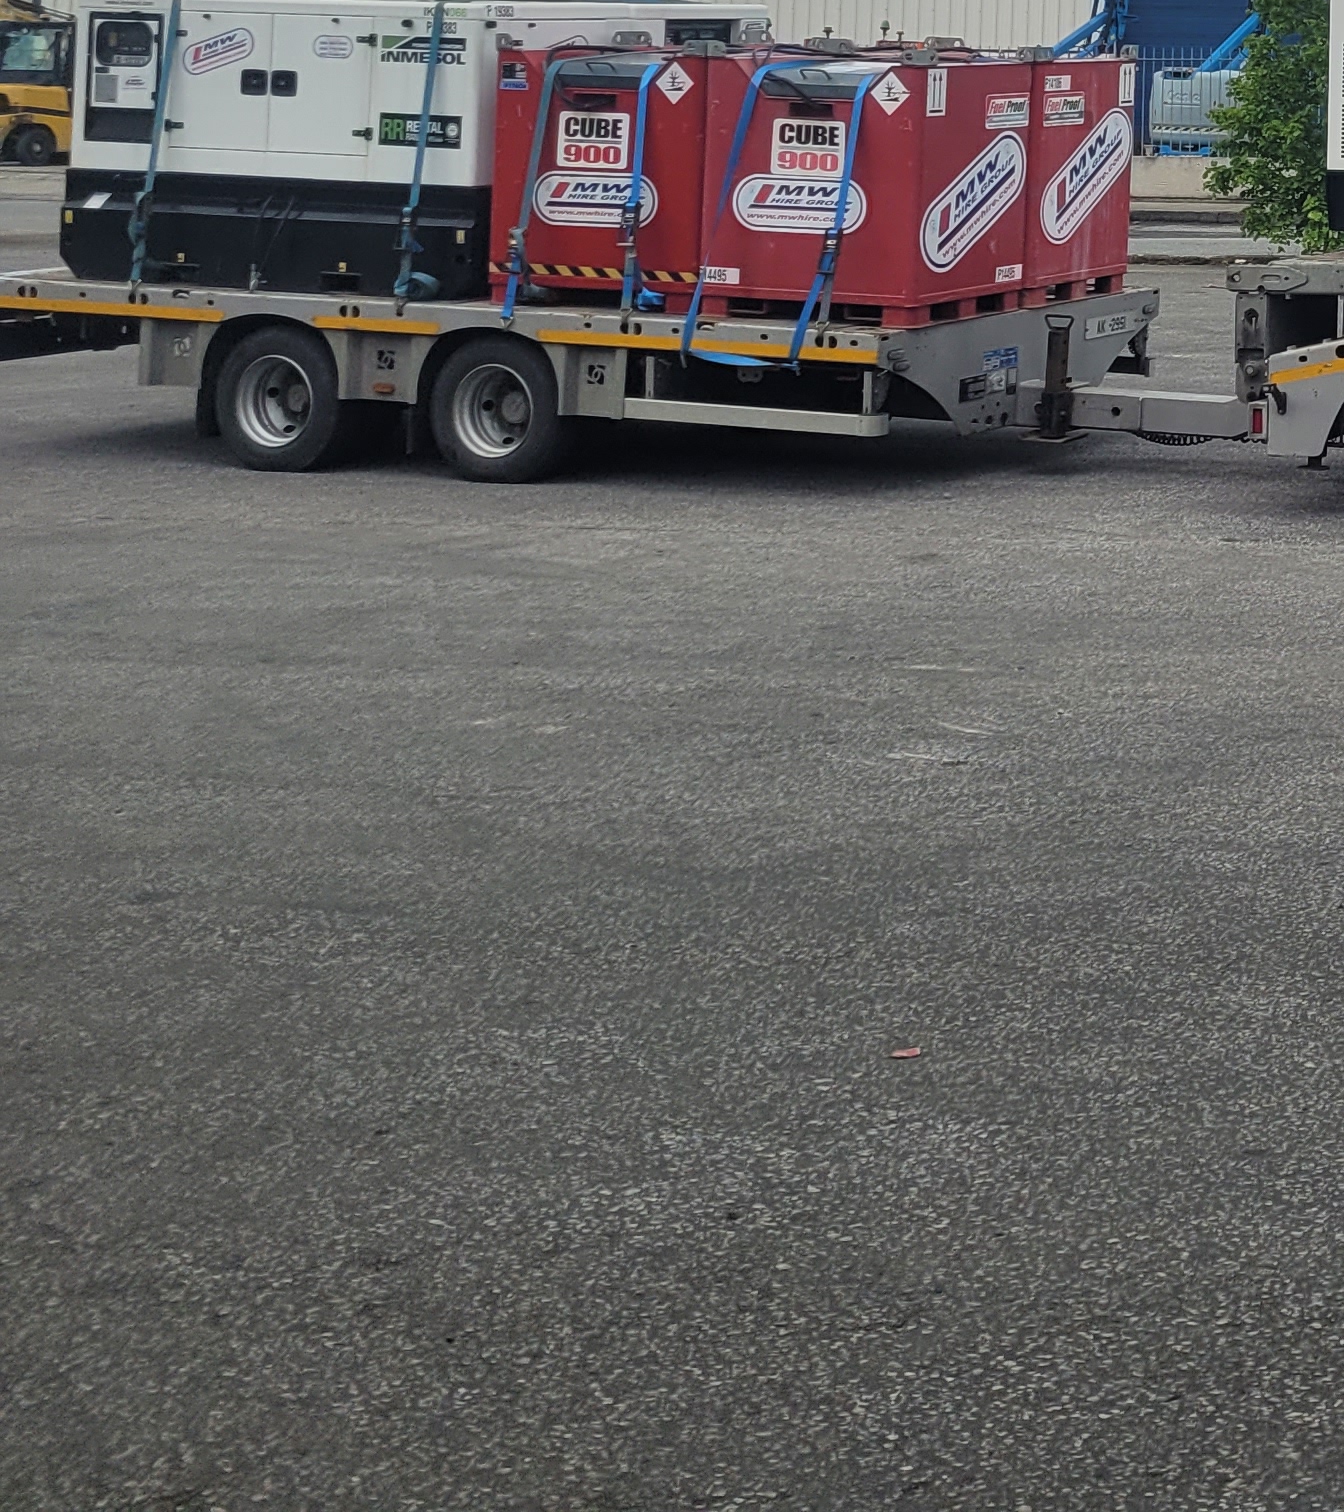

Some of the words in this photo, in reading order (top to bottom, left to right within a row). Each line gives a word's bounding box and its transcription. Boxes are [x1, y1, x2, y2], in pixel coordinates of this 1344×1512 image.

[203, 34, 238, 52] MW
[381, 118, 405, 141] RR
[564, 116, 623, 139] CUBE
[779, 123, 839, 147] CUBE
[563, 144, 621, 165] 900
[777, 151, 839, 172] 900
[1069, 125, 1109, 185] MW
[572, 182, 635, 194] MW
[776, 185, 839, 198] MW
[954, 150, 1002, 210] MW
[1068, 169, 1090, 199] HIRE
[770, 197, 802, 205] HIRE
[953, 191, 978, 224] HIRE
